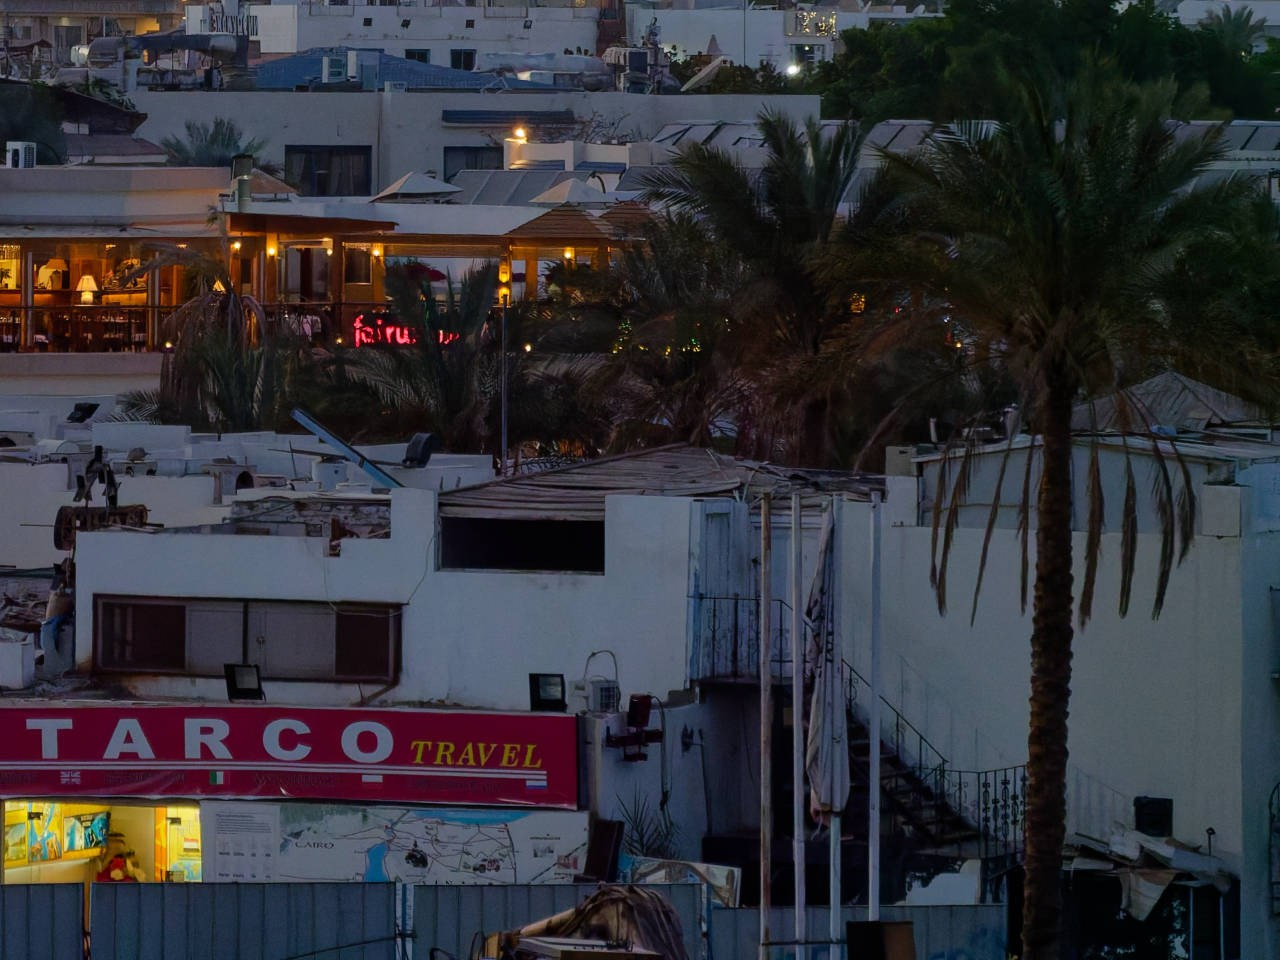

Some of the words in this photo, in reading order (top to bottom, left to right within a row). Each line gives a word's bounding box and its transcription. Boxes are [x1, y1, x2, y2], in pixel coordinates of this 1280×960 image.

[353, 314, 417, 348] fairu
[410, 739, 543, 770] TRAVEL
[294, 841, 335, 849] CAIRO
